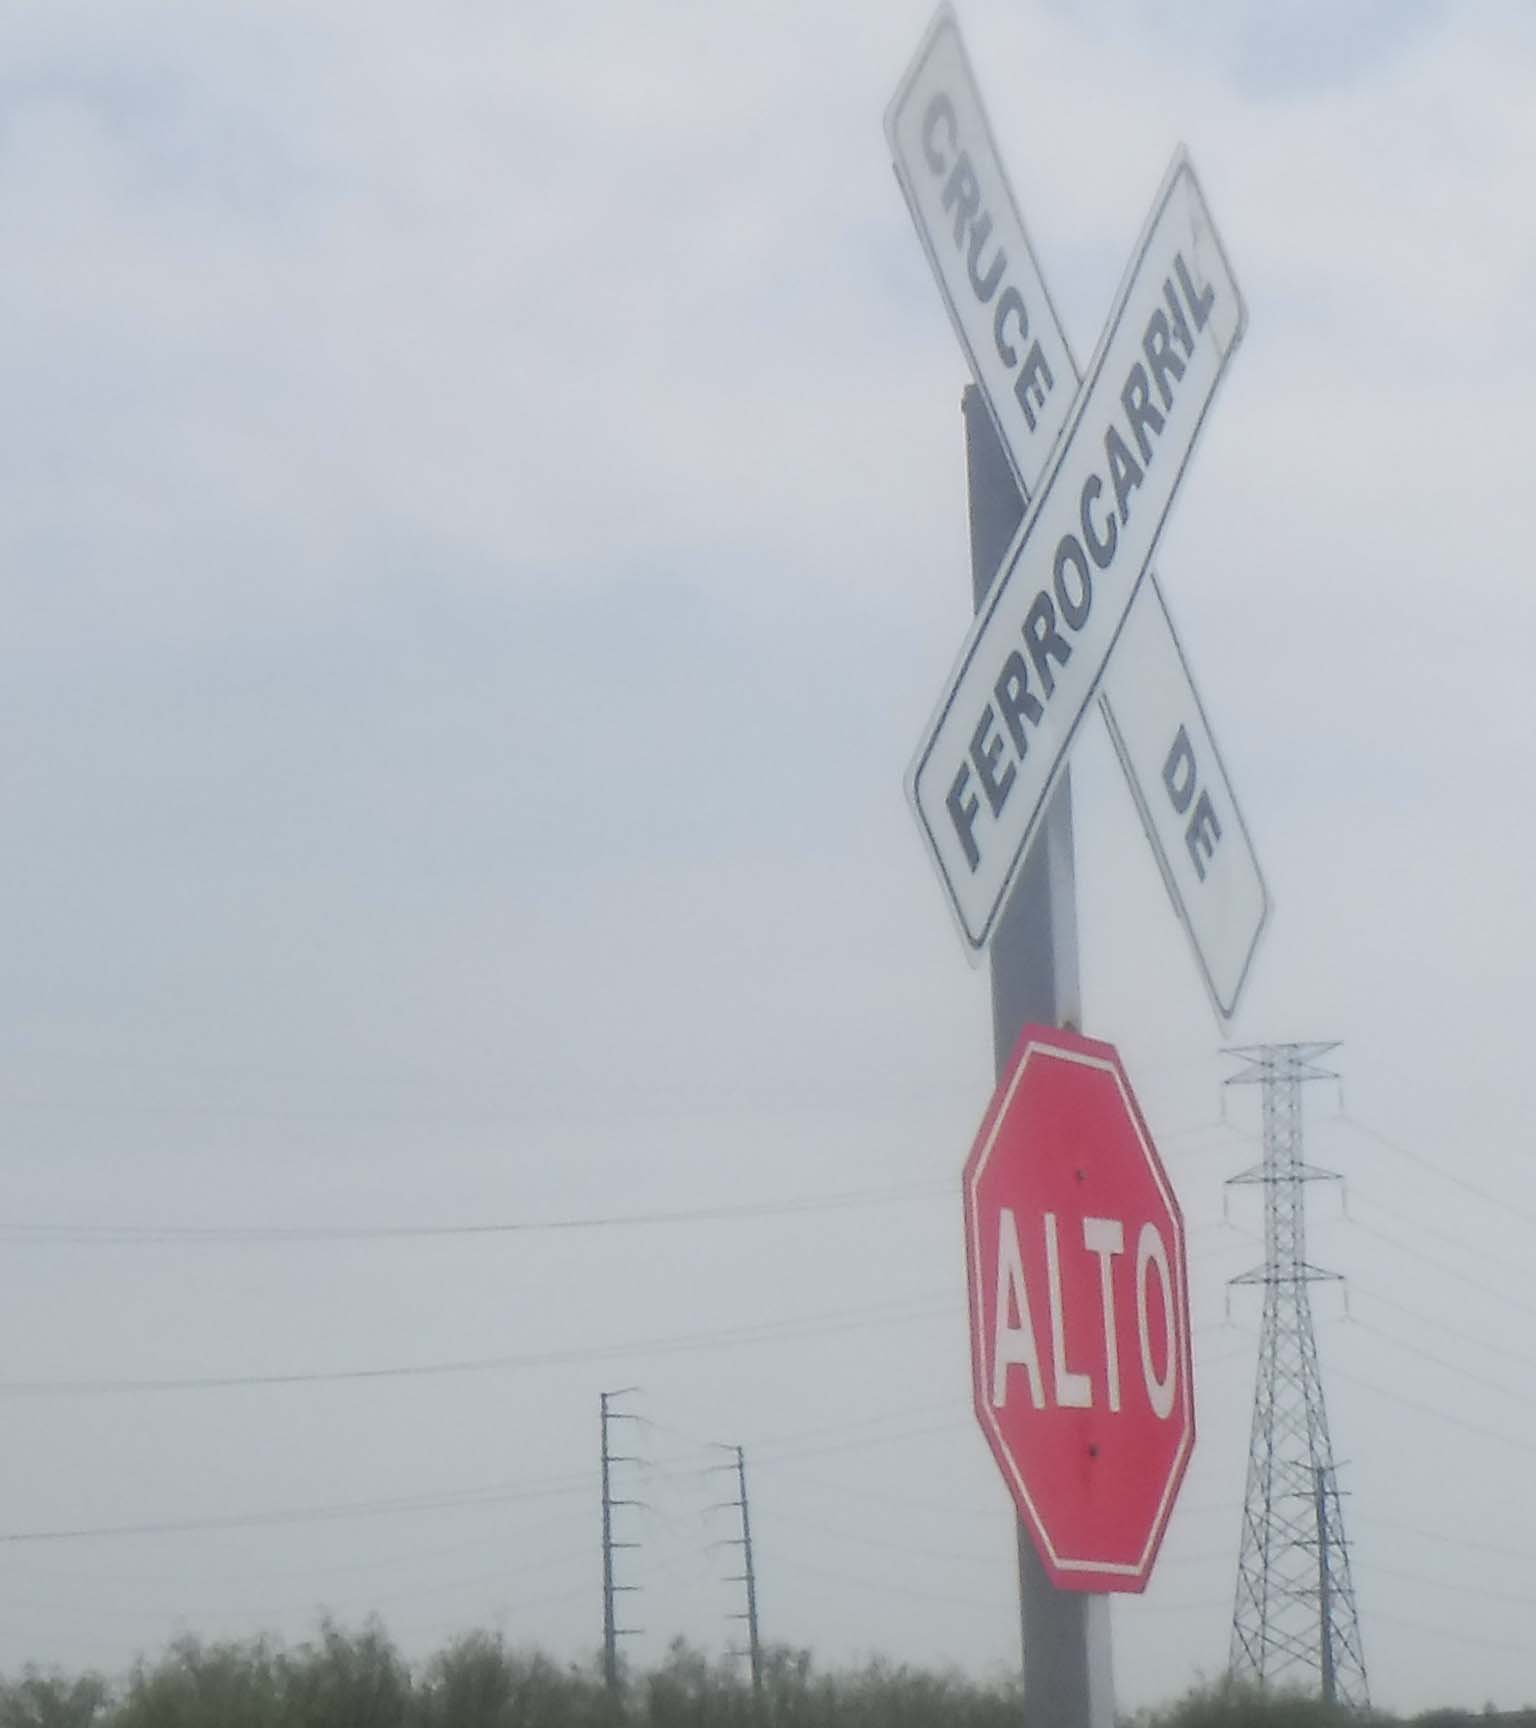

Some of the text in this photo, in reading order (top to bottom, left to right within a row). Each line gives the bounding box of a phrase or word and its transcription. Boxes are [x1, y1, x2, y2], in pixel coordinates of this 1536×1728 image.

[921, 92, 1054, 433] CRUCE
[946, 252, 1216, 873] FERROCARRIL
[1162, 724, 1222, 882] DE
[992, 1207, 1177, 1420] ALTO
